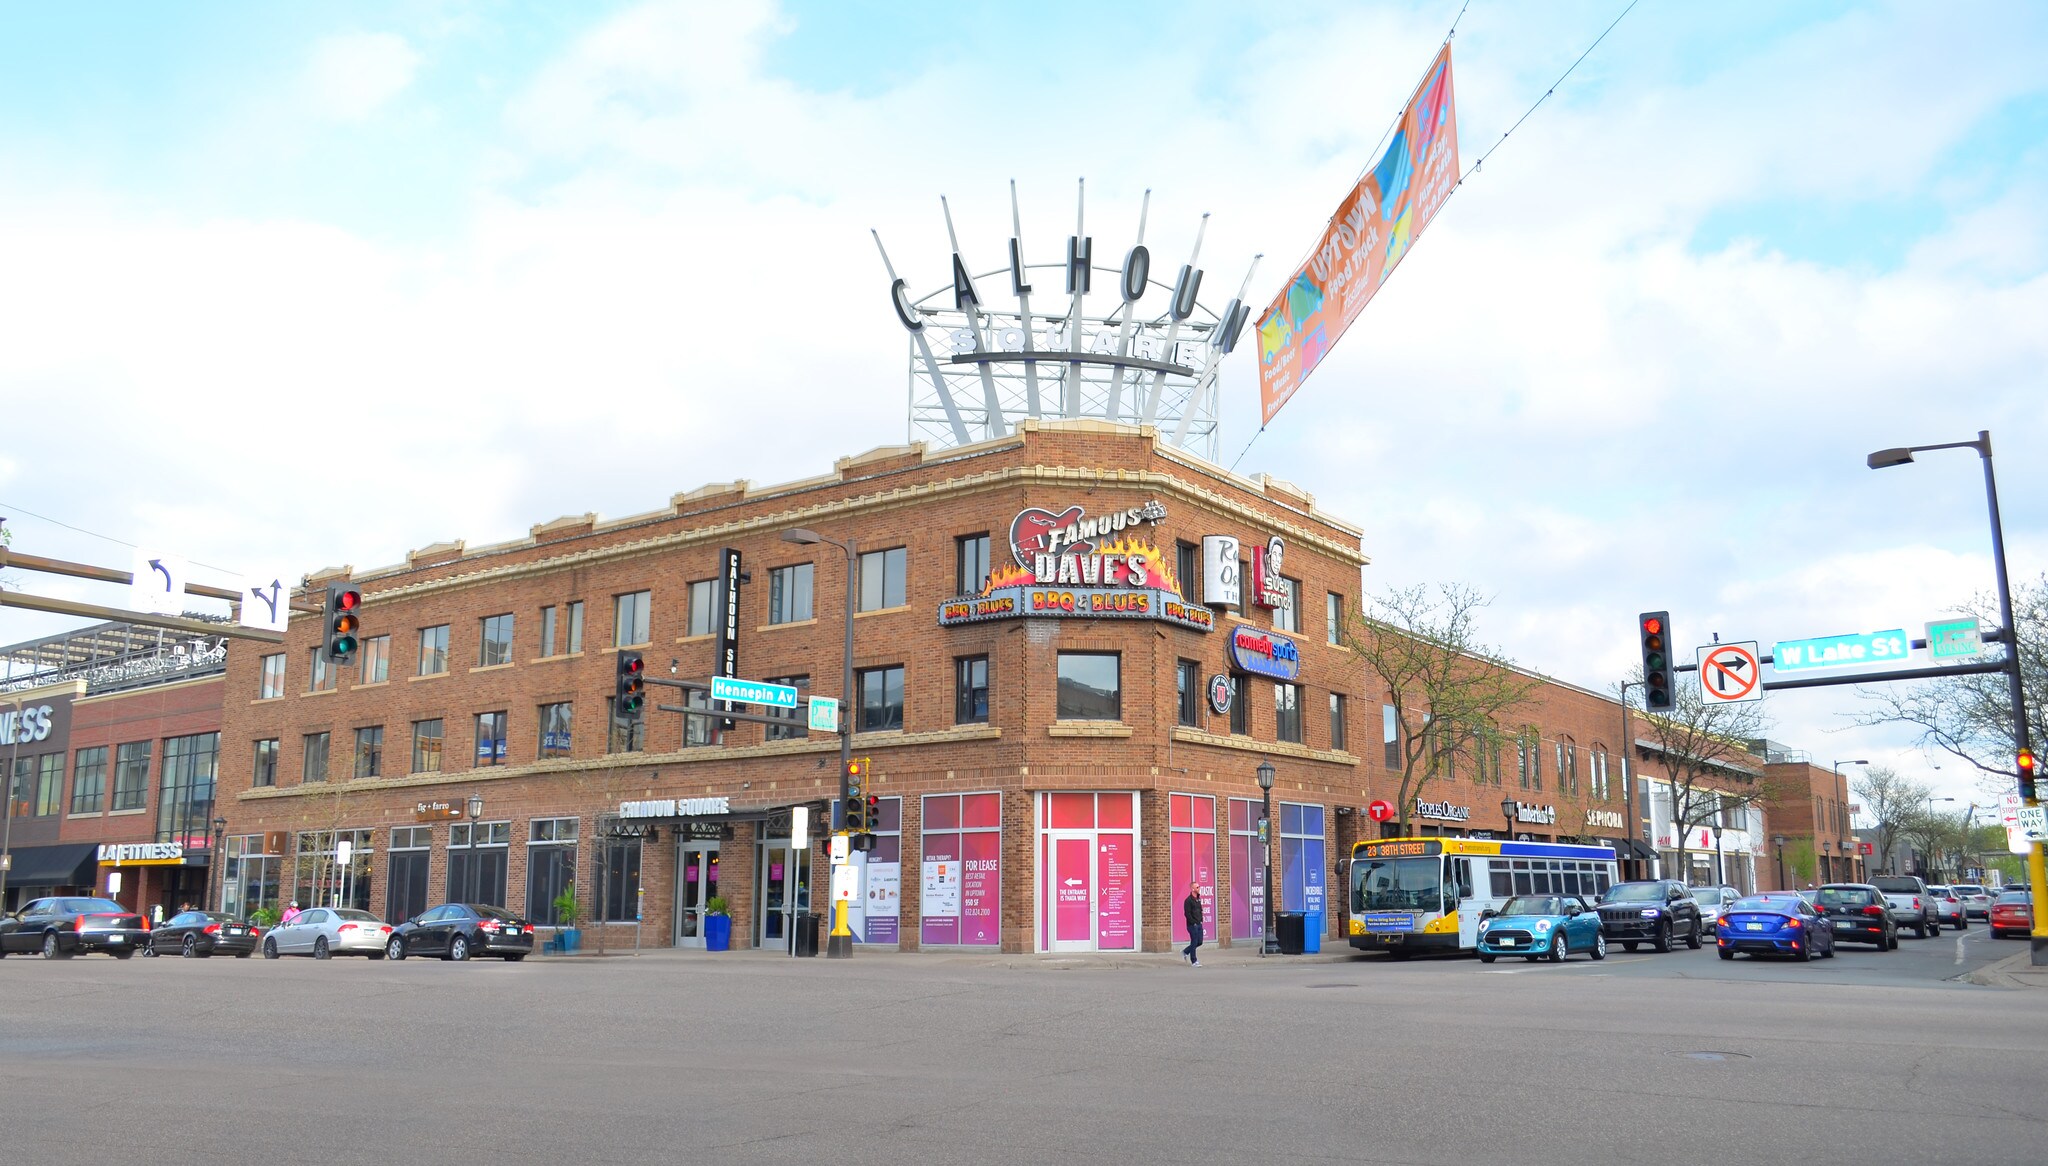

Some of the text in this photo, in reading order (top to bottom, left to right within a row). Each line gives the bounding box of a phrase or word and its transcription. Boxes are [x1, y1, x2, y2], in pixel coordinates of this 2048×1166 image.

[1424, 133, 1449, 175] unday,
[1311, 187, 1378, 282] UPTOWN
[891, 235, 1252, 353] CALHOUN
[949, 327, 1198, 368] SQUARE
[1272, 370, 1291, 394] Music
[1048, 506, 1142, 553] FAMOUS
[1035, 552, 1149, 586] DAVE'S
[727, 553, 738, 641] CALHOUN
[944, 604, 969, 619] BBQ
[978, 597, 1014, 616] BLUES
[1032, 591, 1150, 613] BBQ & BLUES
[1261, 591, 1292, 611] TANGO
[1166, 602, 1185, 618] BBQ
[1189, 608, 1212, 626] BLUES
[1782, 638, 1902, 665] W Lake St
[715, 681, 794, 704] Hennepin Av
[417, 802, 427, 813] fig
[432, 801, 450, 811] farro
[620, 797, 730, 819] CALHOUN SQUARE
[2007, 796, 2018, 804] NO
[1516, 801, 1548, 824] Timberland
[1586, 809, 1624, 829] SEPHORA
[2020, 810, 2042, 818] ONE
[2020, 819, 2044, 828] WAY
[97, 844, 117, 861] LA
[120, 842, 184, 860] FITNESS
[1367, 843, 1426, 857] 23 38TH STREET
[965, 860, 997, 871] FOR LEASE
